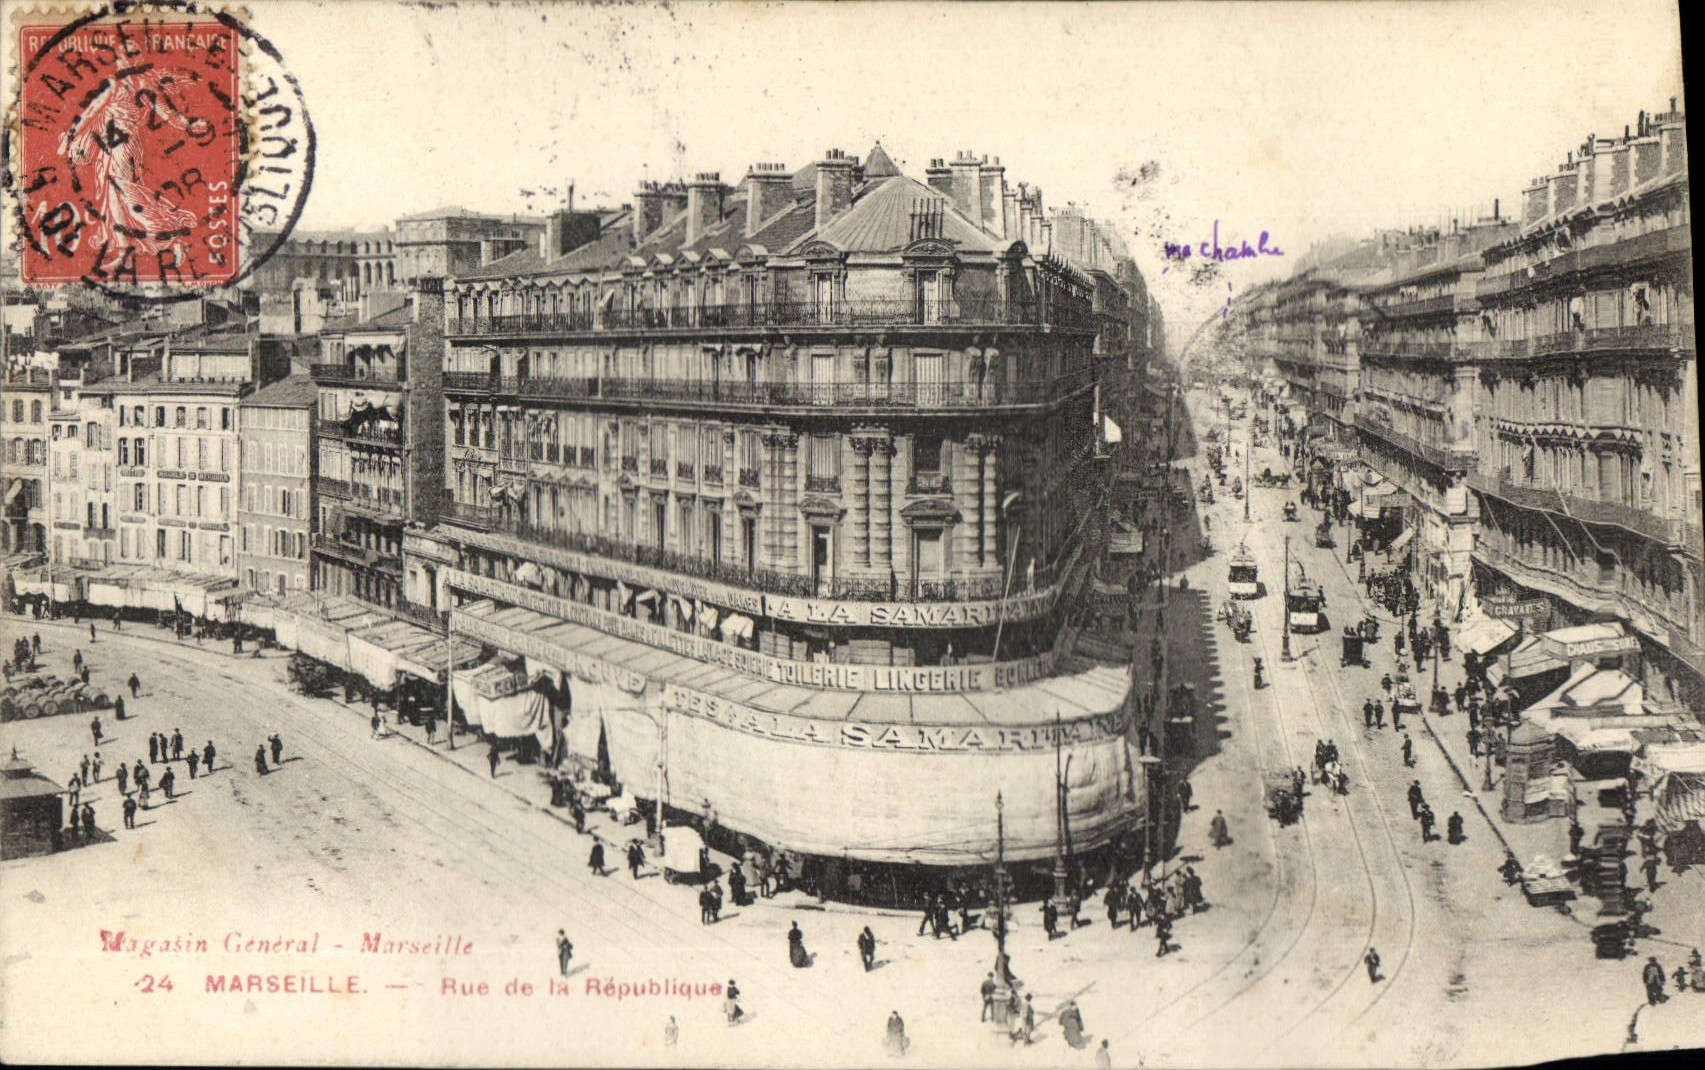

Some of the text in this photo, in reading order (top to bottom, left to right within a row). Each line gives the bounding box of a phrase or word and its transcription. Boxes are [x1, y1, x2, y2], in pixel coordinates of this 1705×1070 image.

[807, 602, 857, 624] LA
[777, 660, 859, 690] TOILERIE
[874, 668, 982, 692] LINGERIE
[841, 711, 1122, 751] SAMARITAINE
